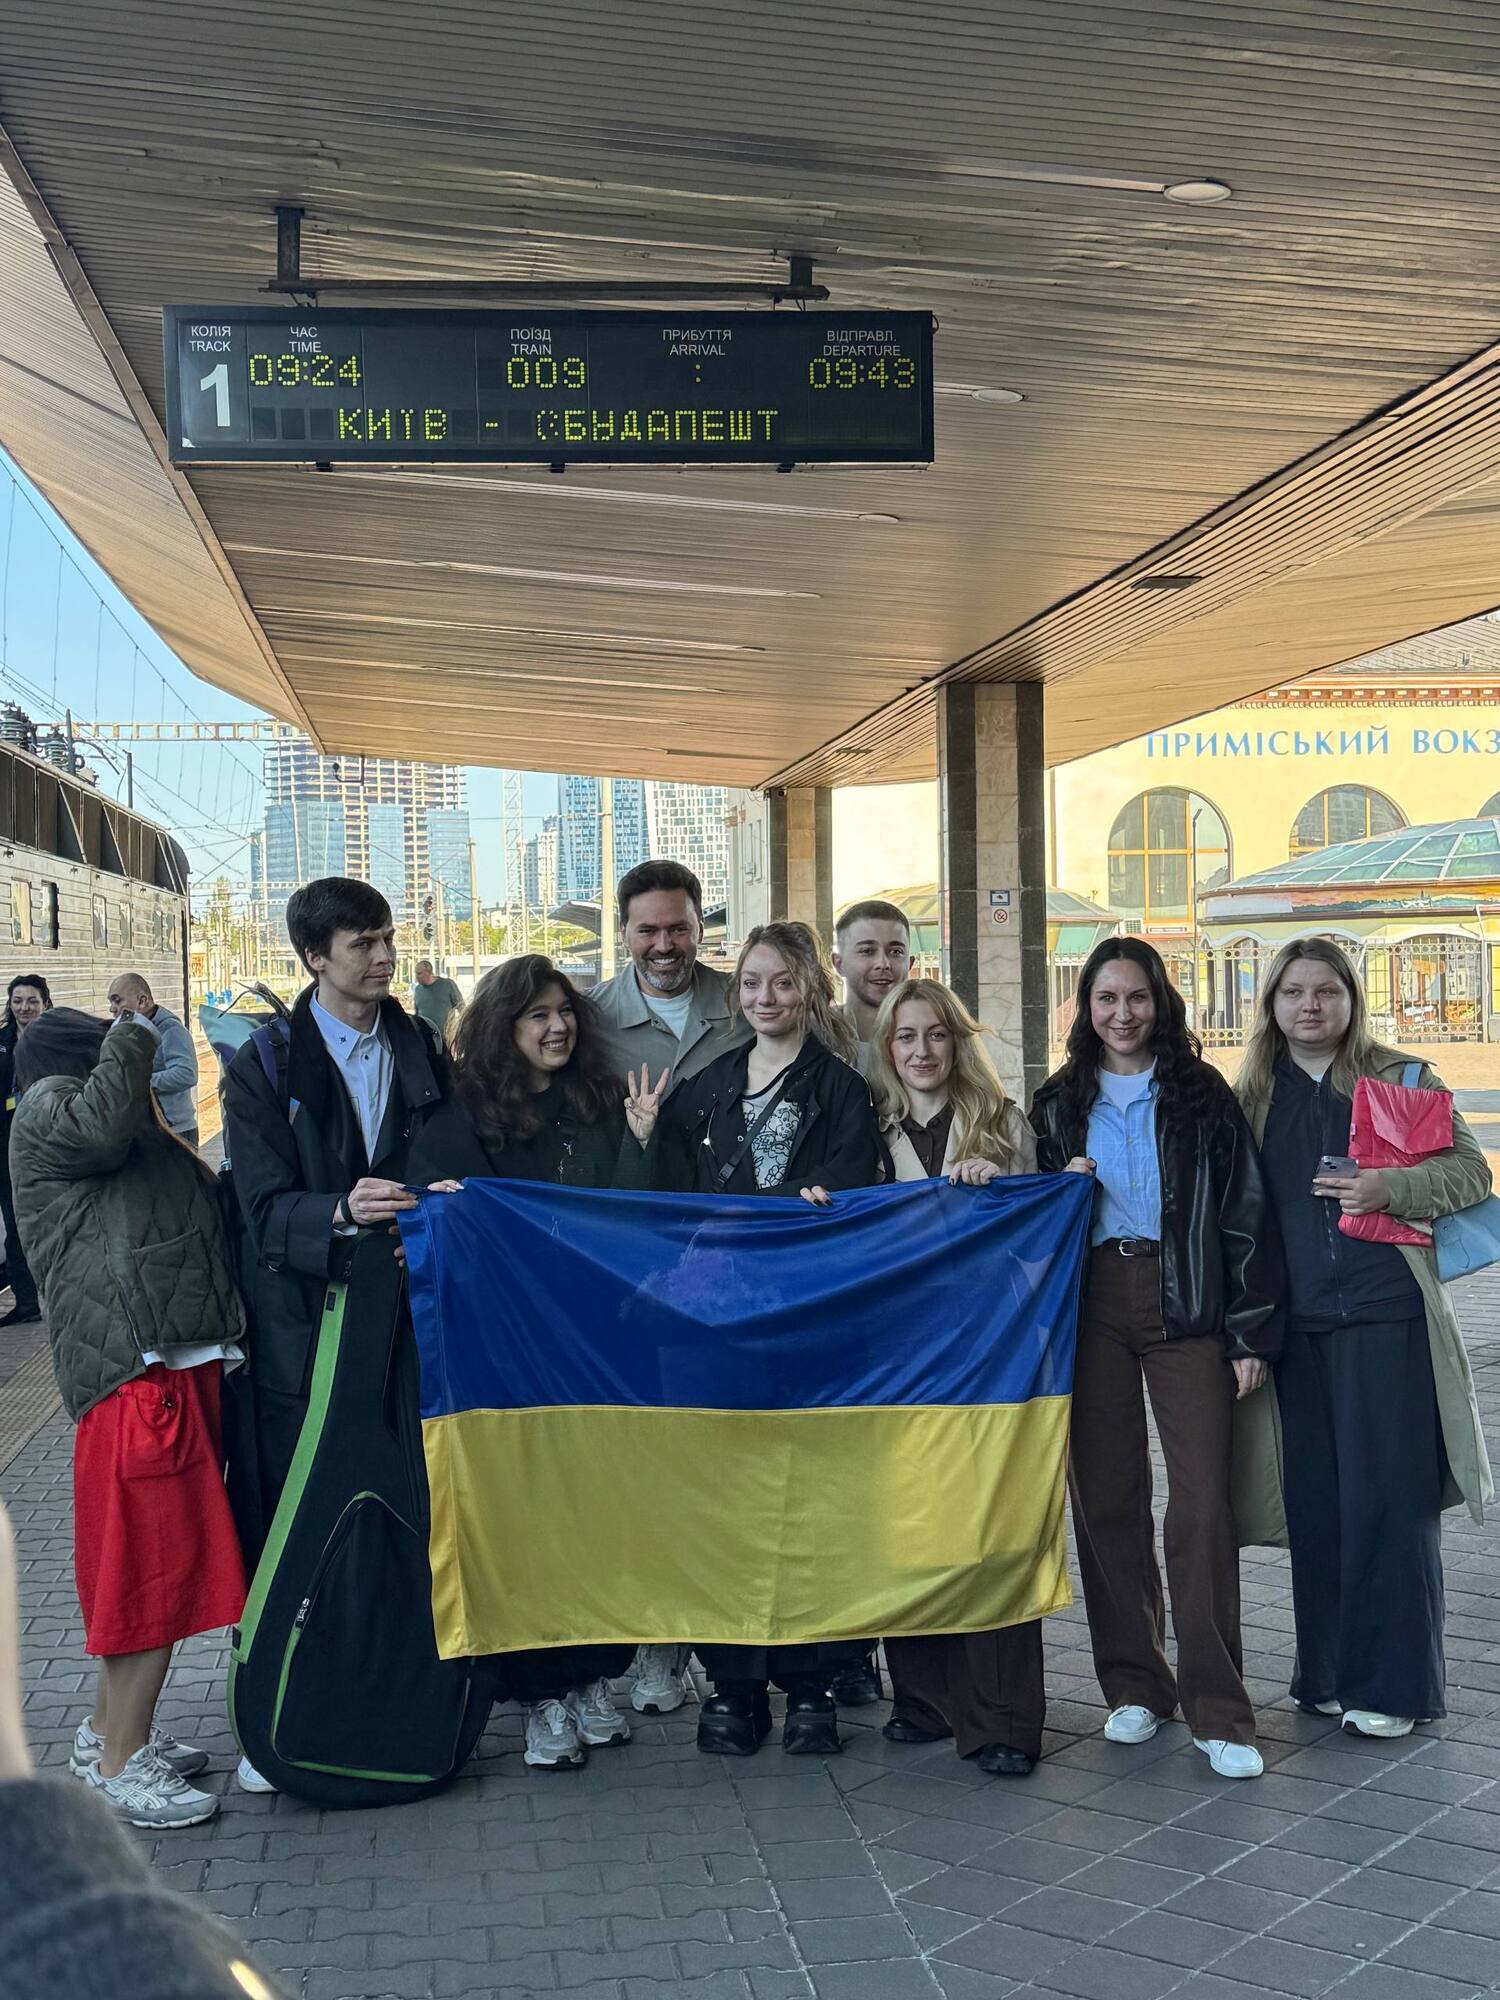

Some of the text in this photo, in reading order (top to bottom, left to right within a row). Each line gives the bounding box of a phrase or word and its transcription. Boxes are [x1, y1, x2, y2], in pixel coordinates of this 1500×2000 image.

[191, 326, 231, 337] КОЛІЯ
[290, 327, 318, 339] ЧАС
[510, 327, 551, 342] ПОЇЗД
[662, 329, 731, 341] ПРИБУТТЯ
[827, 330, 897, 344] ВІДПРАВЛ.
[189, 341, 231, 352] TRACK
[289, 341, 322, 353] TIME
[511, 343, 552, 355] TRAIN
[669, 344, 726, 356] ARRIVAL
[823, 345, 901, 357] DEPARTURE
[250, 354, 361, 387] 09:24
[507, 357, 585, 388] 009
[809, 358, 915, 388] 09:43
[200, 364, 231, 427] 1
[1147, 725, 1388, 758] ПРИМІСЬКИЙ
